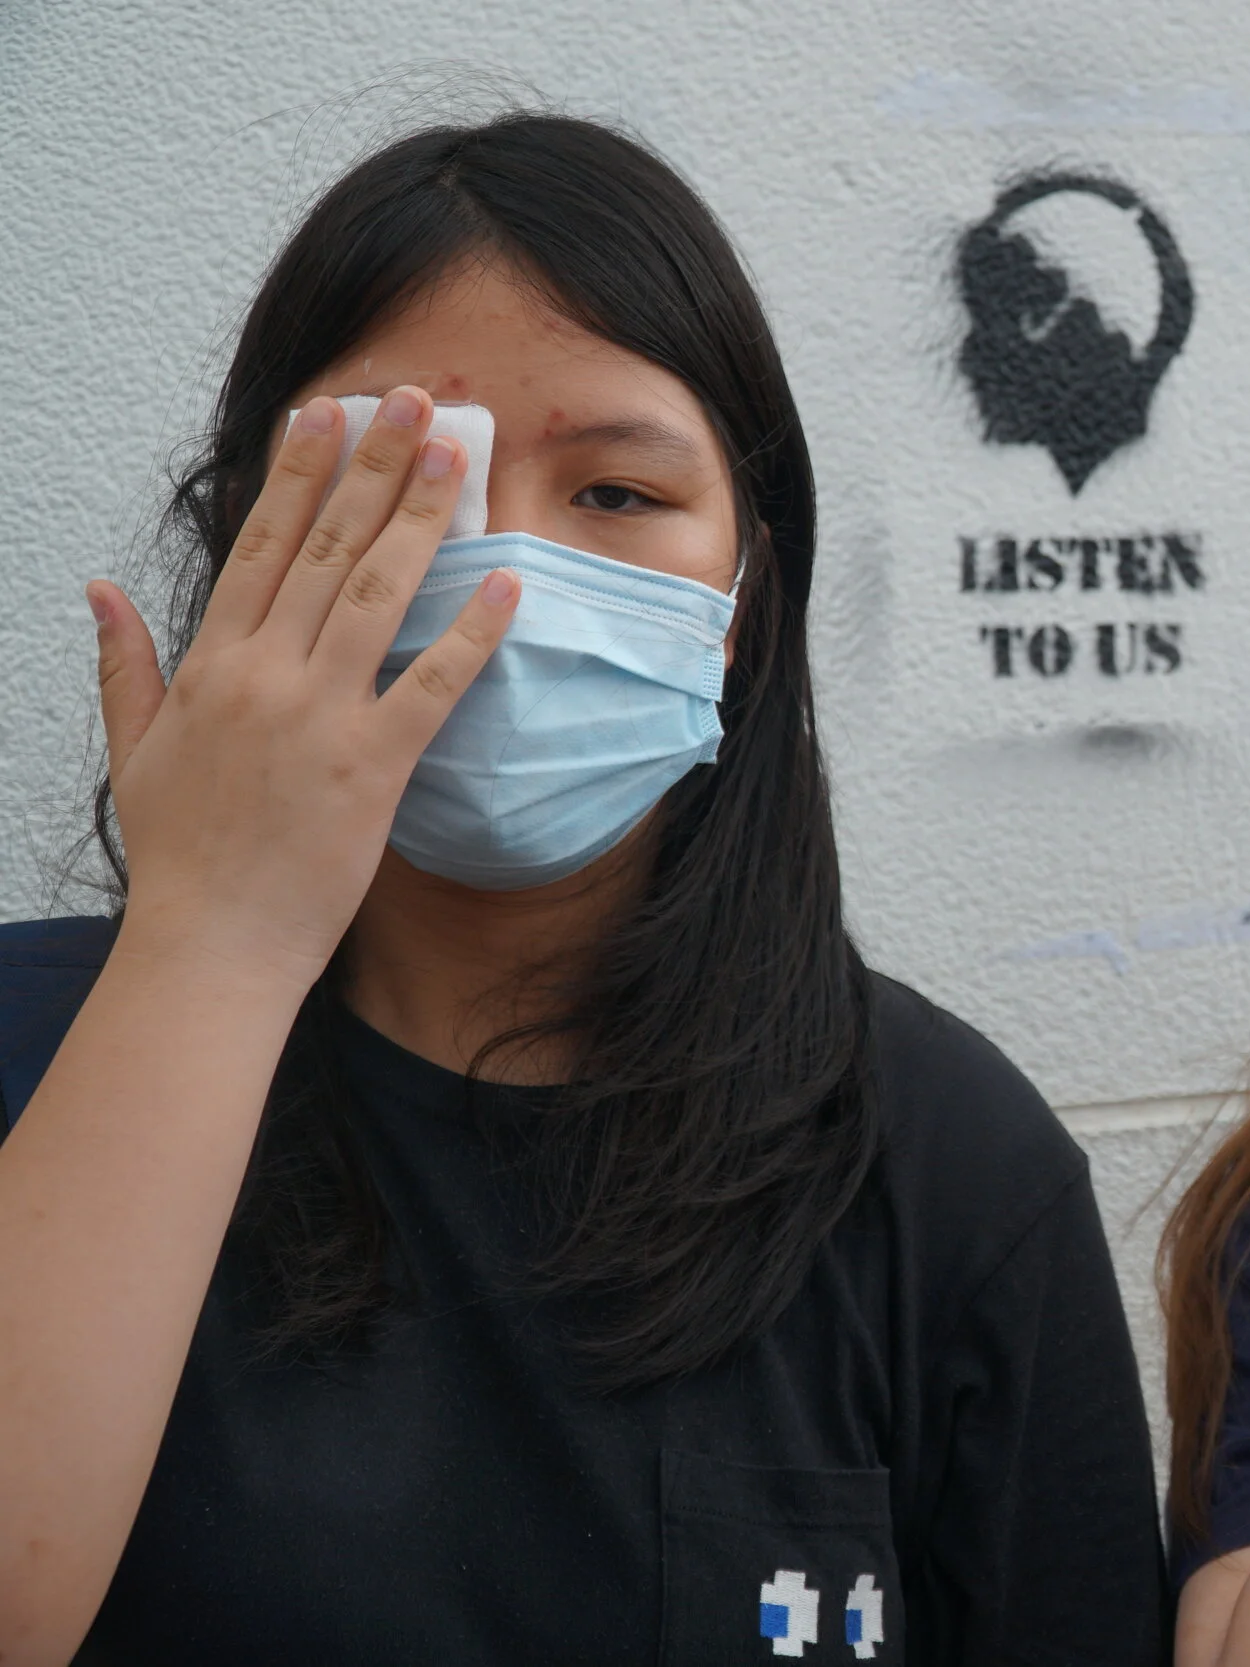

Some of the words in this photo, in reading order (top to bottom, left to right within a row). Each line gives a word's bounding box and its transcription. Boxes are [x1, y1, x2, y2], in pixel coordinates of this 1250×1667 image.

[957, 532, 1206, 594] LISTEN
[979, 623, 1074, 678] TO
[1096, 622, 1183, 678] US
